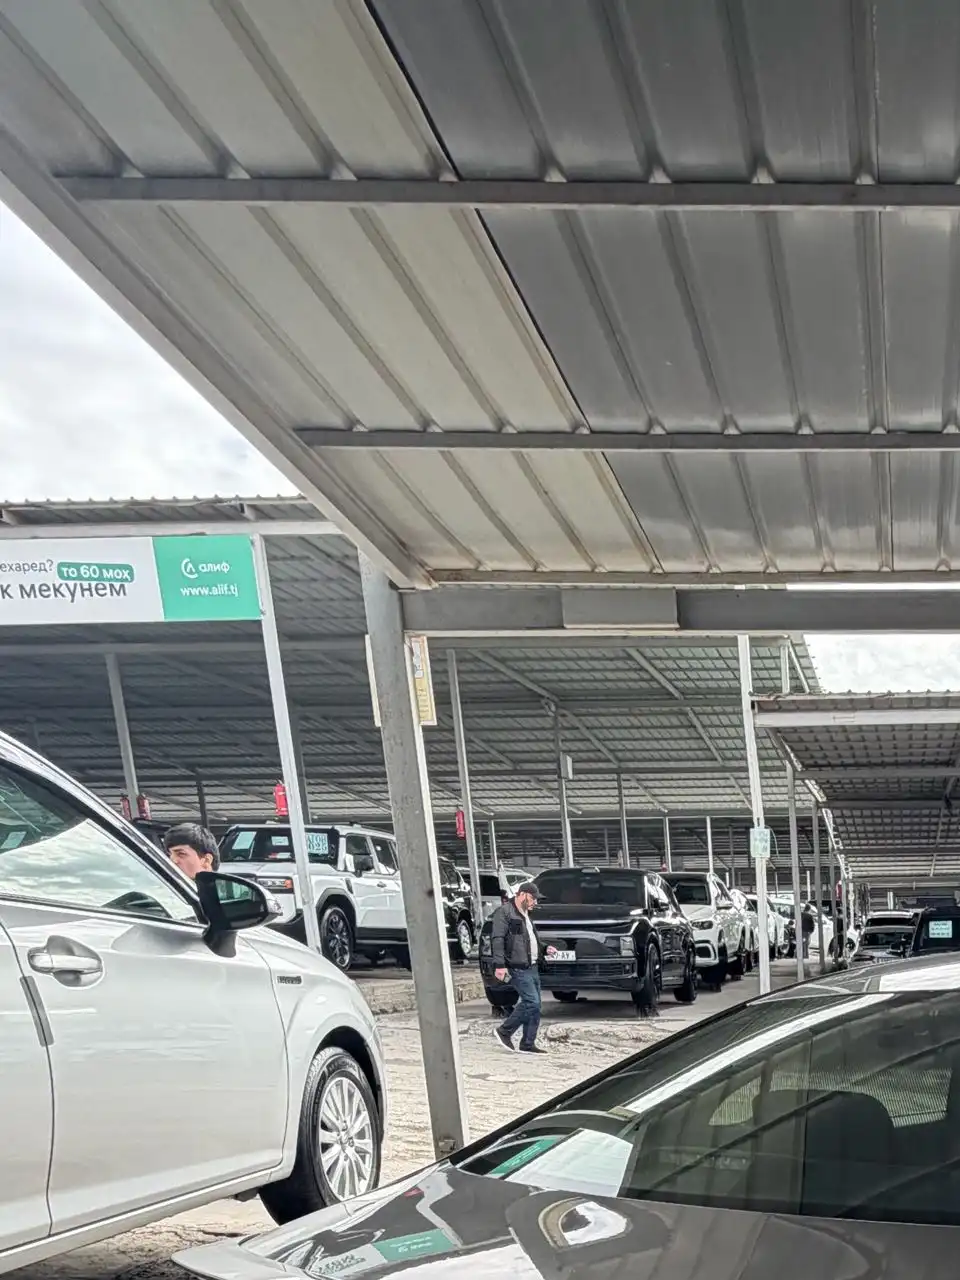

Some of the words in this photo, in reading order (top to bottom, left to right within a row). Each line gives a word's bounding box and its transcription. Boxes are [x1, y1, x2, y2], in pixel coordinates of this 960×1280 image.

[61, 567, 78, 578] то
[80, 565, 100, 578] 60
[19, 582, 127, 603] мекунем
[180, 584, 239, 597] www.alif.tj
